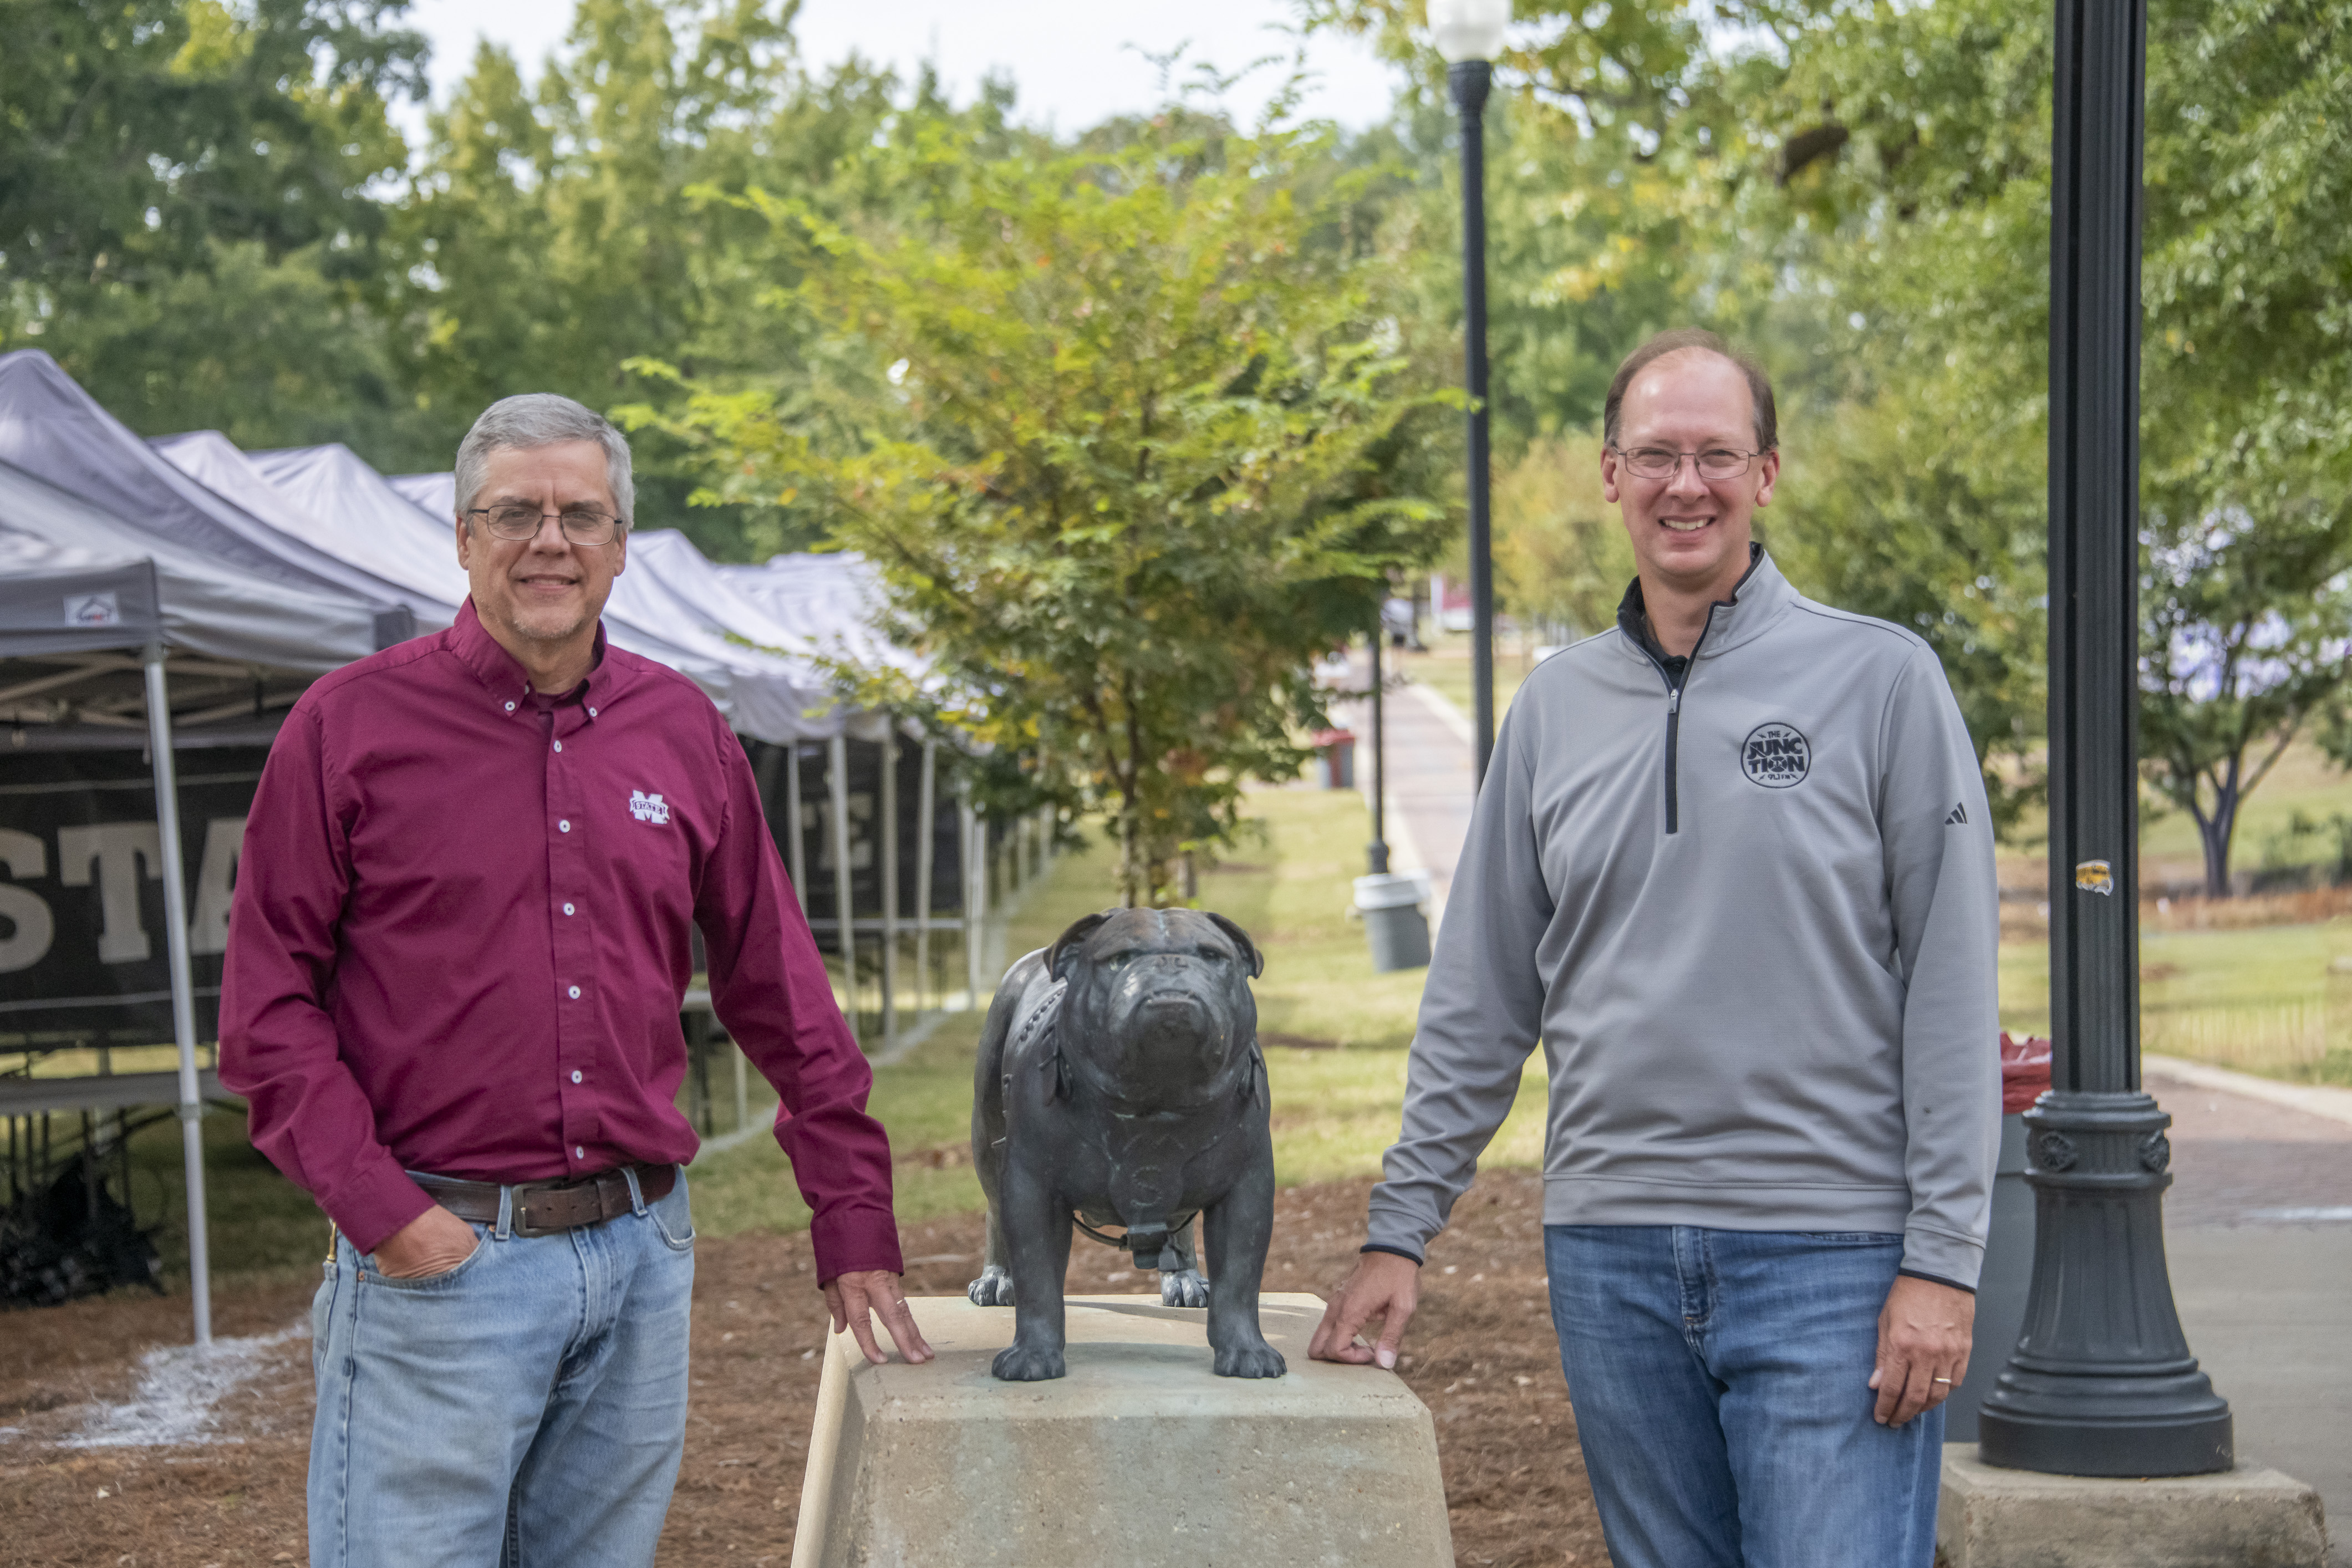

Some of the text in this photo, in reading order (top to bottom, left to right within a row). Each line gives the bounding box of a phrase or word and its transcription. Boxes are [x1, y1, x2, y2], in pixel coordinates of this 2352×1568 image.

[1747, 737, 1803, 760] JUNC
[1748, 755, 1805, 774] TION
[635, 802, 661, 814] STATE
